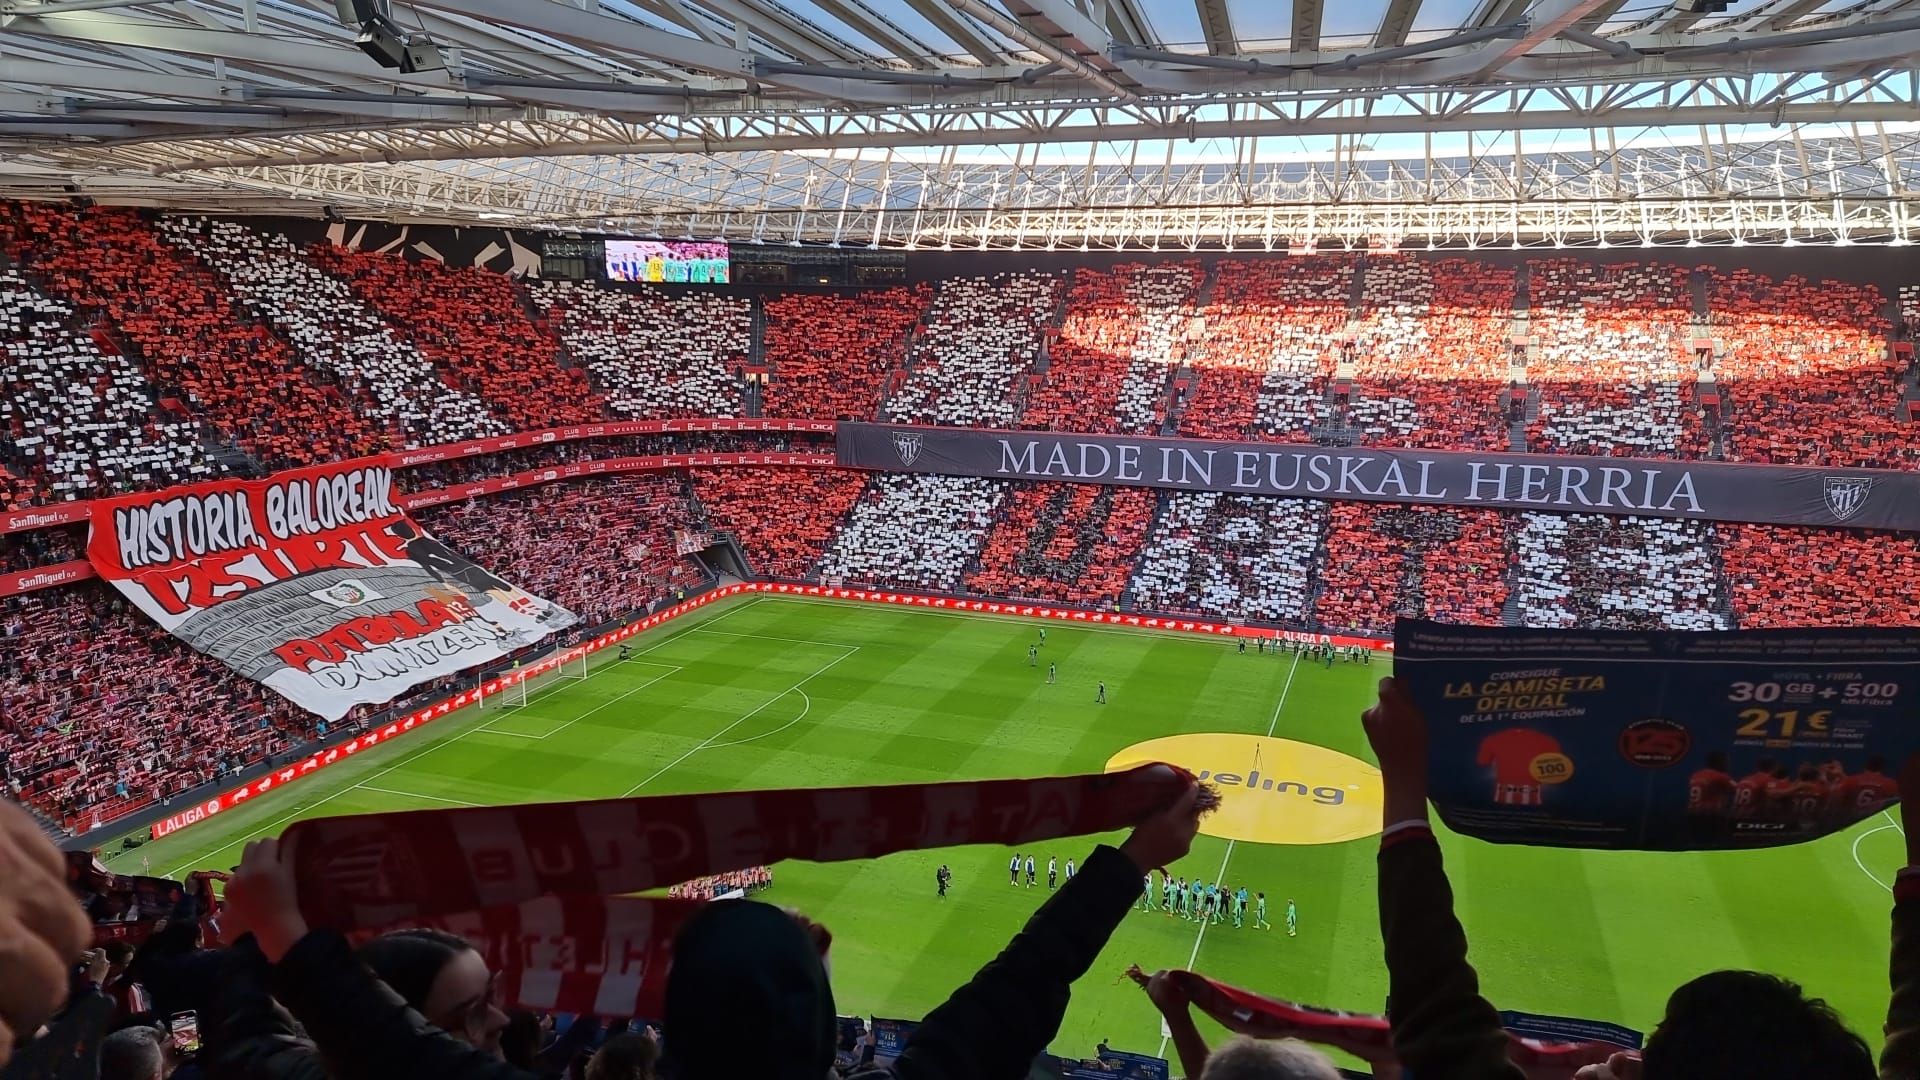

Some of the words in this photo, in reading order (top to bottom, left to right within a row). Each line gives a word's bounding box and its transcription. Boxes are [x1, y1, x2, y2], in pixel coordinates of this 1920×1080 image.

[997, 438, 1143, 482] MADE
[1157, 447, 1213, 487] IN
[1231, 451, 1447, 499] EUSKAL
[1466, 462, 1706, 514] HERRIA
[116, 491, 268, 570] HISTORIA,
[1490, 668, 1561, 681] CONSIGUE
[1443, 681, 1474, 698] LA
[1480, 675, 1606, 696] CAMISETA
[1728, 681, 1780, 703] 30
[1785, 683, 1816, 694] GB
[1843, 682, 1899, 698] 500
[1476, 694, 1570, 712] OFICIAL
[1459, 714, 1477, 724] DE
[1478, 713, 1493, 723] LA
[1512, 707, 1586, 720] EQUIPACIÓN
[1735, 706, 1799, 738] 21
[1806, 709, 1833, 731] €
[1536, 762, 1566, 775] 100
[157, 806, 205, 837] LALIGA
[1736, 822, 1785, 830] DIGI
